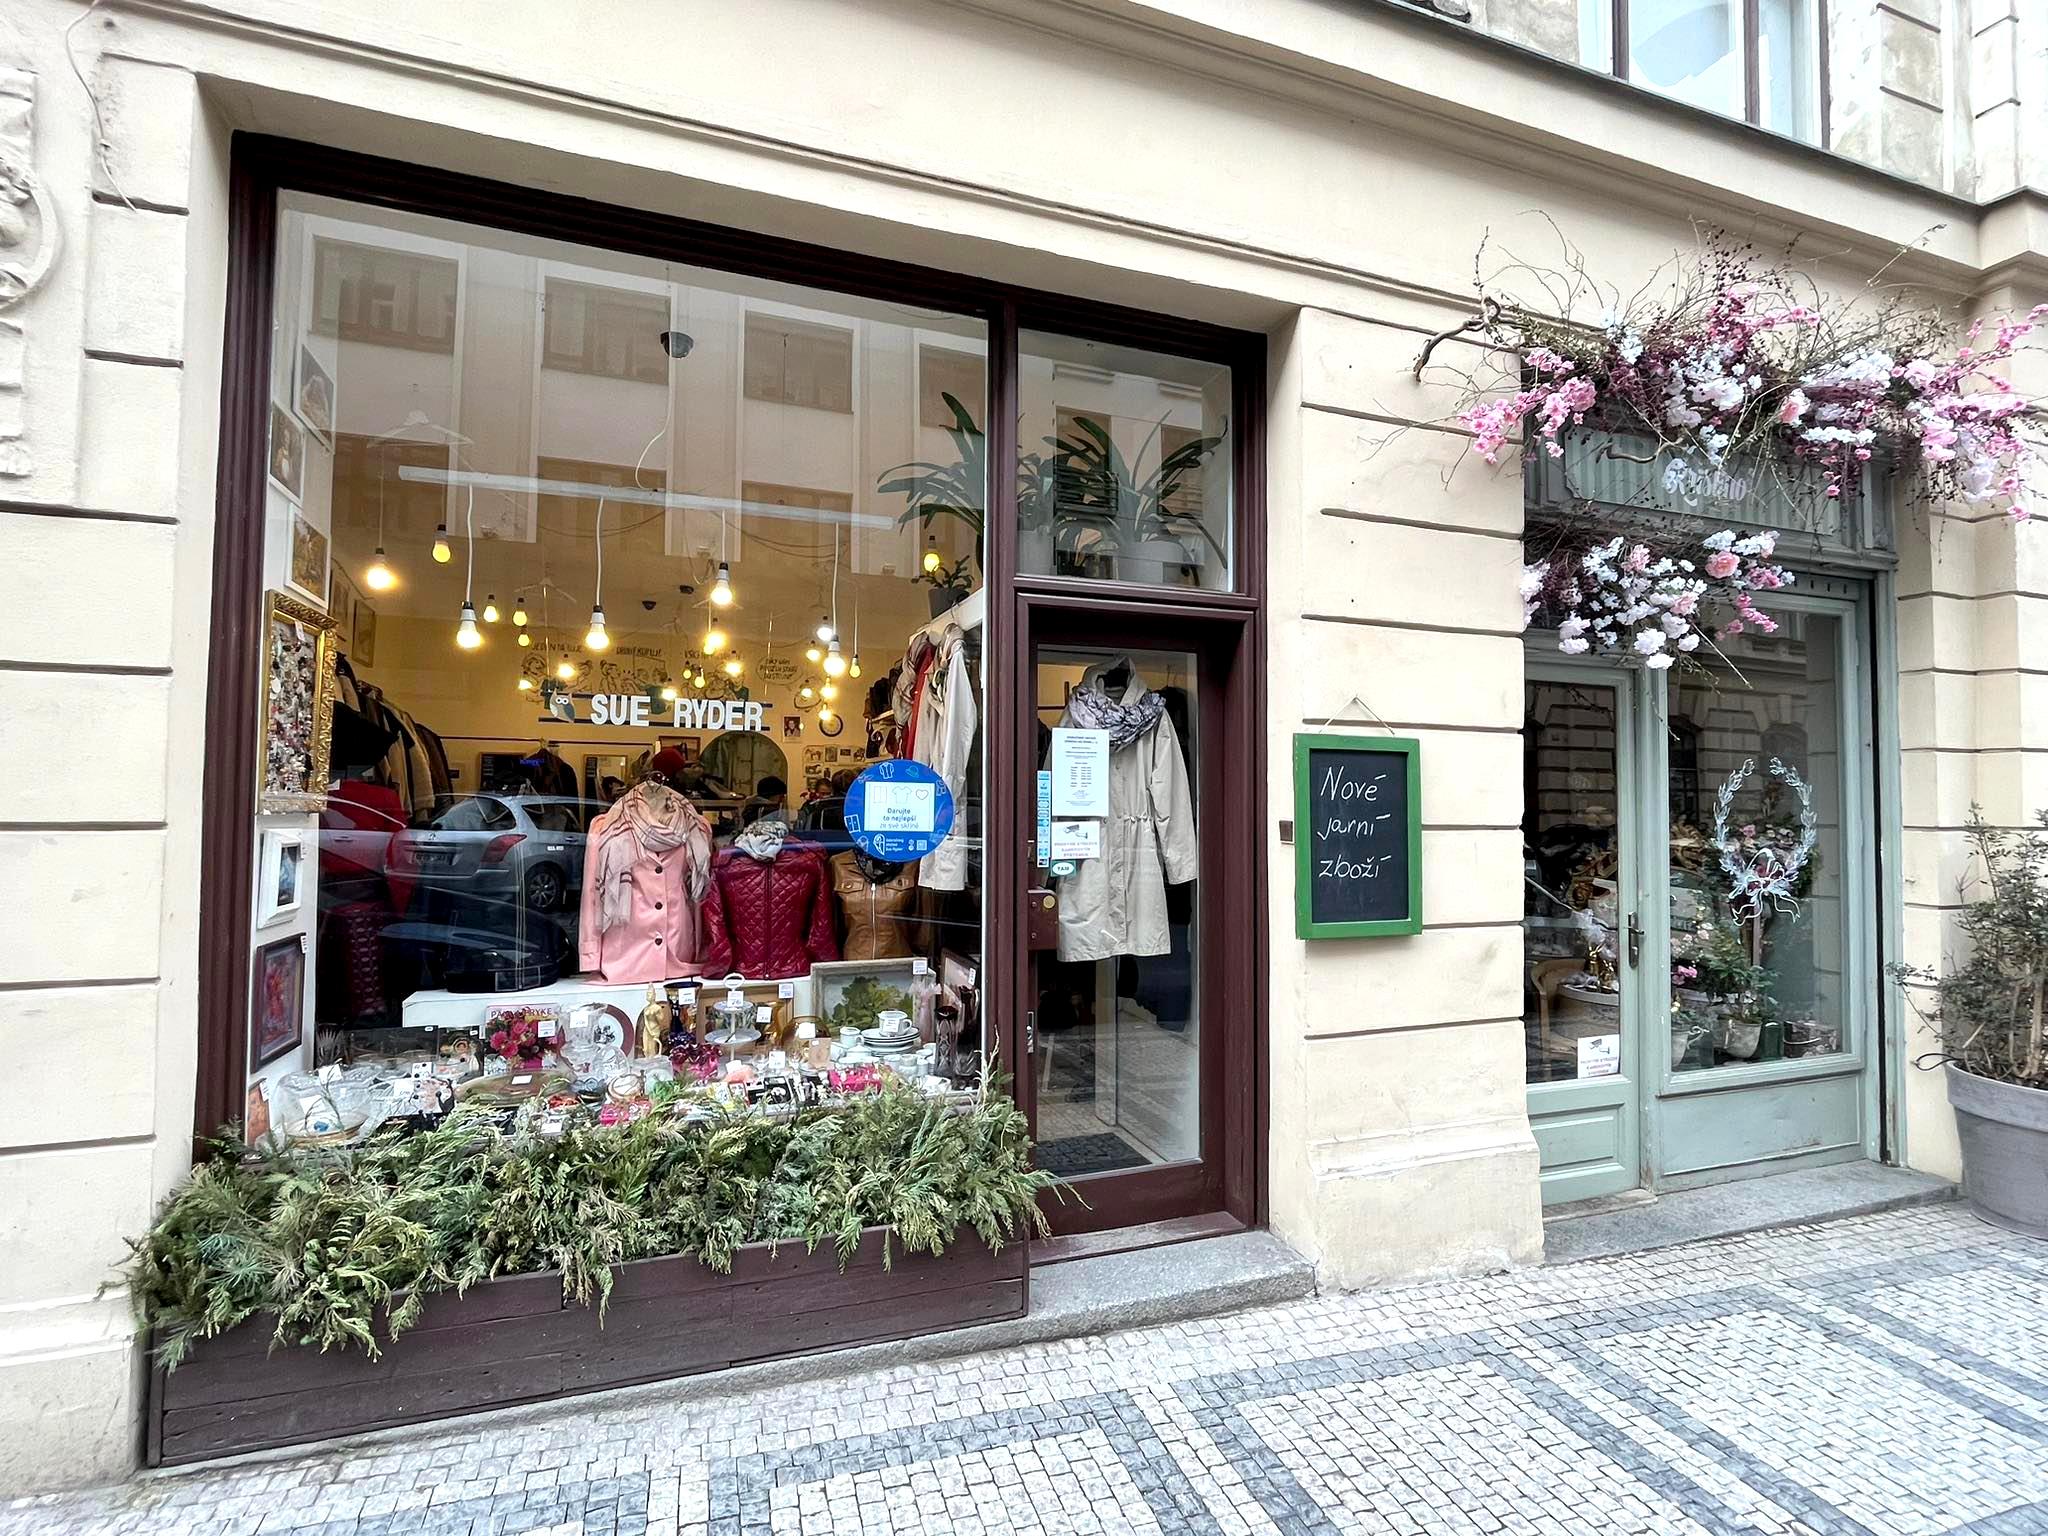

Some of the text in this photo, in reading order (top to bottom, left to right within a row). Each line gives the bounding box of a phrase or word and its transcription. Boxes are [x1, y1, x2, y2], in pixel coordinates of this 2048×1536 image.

[590, 694, 763, 731] SUE RYDER
[1321, 766, 1387, 801] Nové
[887, 808, 911, 816] Darujte
[1317, 814, 1390, 840] jarní
[1319, 854, 1392, 879] zboží
